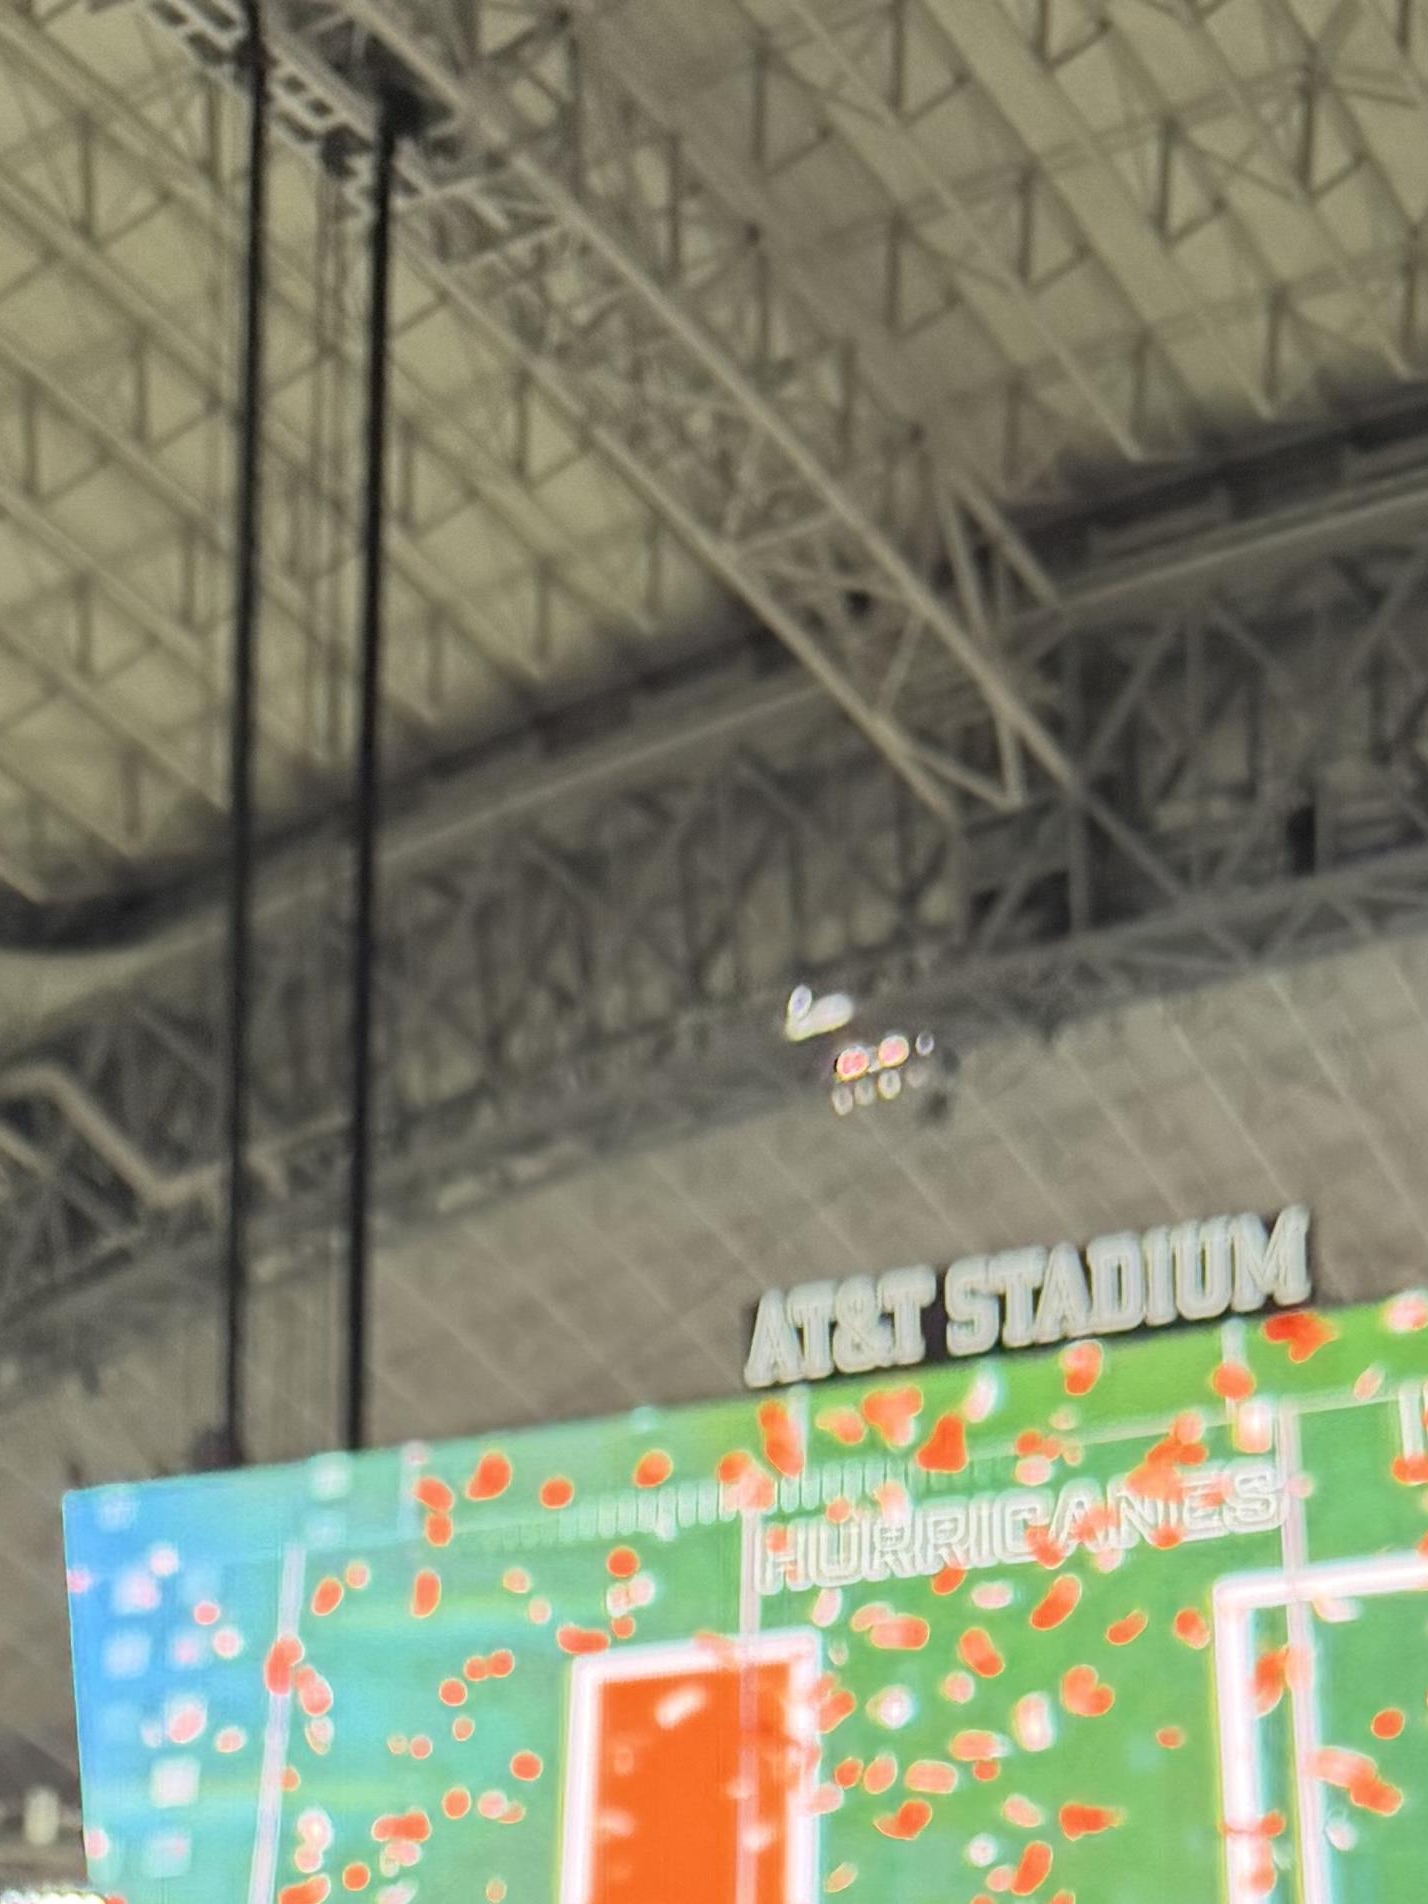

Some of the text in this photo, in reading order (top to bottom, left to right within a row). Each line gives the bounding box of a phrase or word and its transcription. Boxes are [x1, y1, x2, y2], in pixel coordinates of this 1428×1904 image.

[744, 1204, 1314, 1389] AT&T STADIUM
[754, 1459, 1289, 1594] HURRICANES
